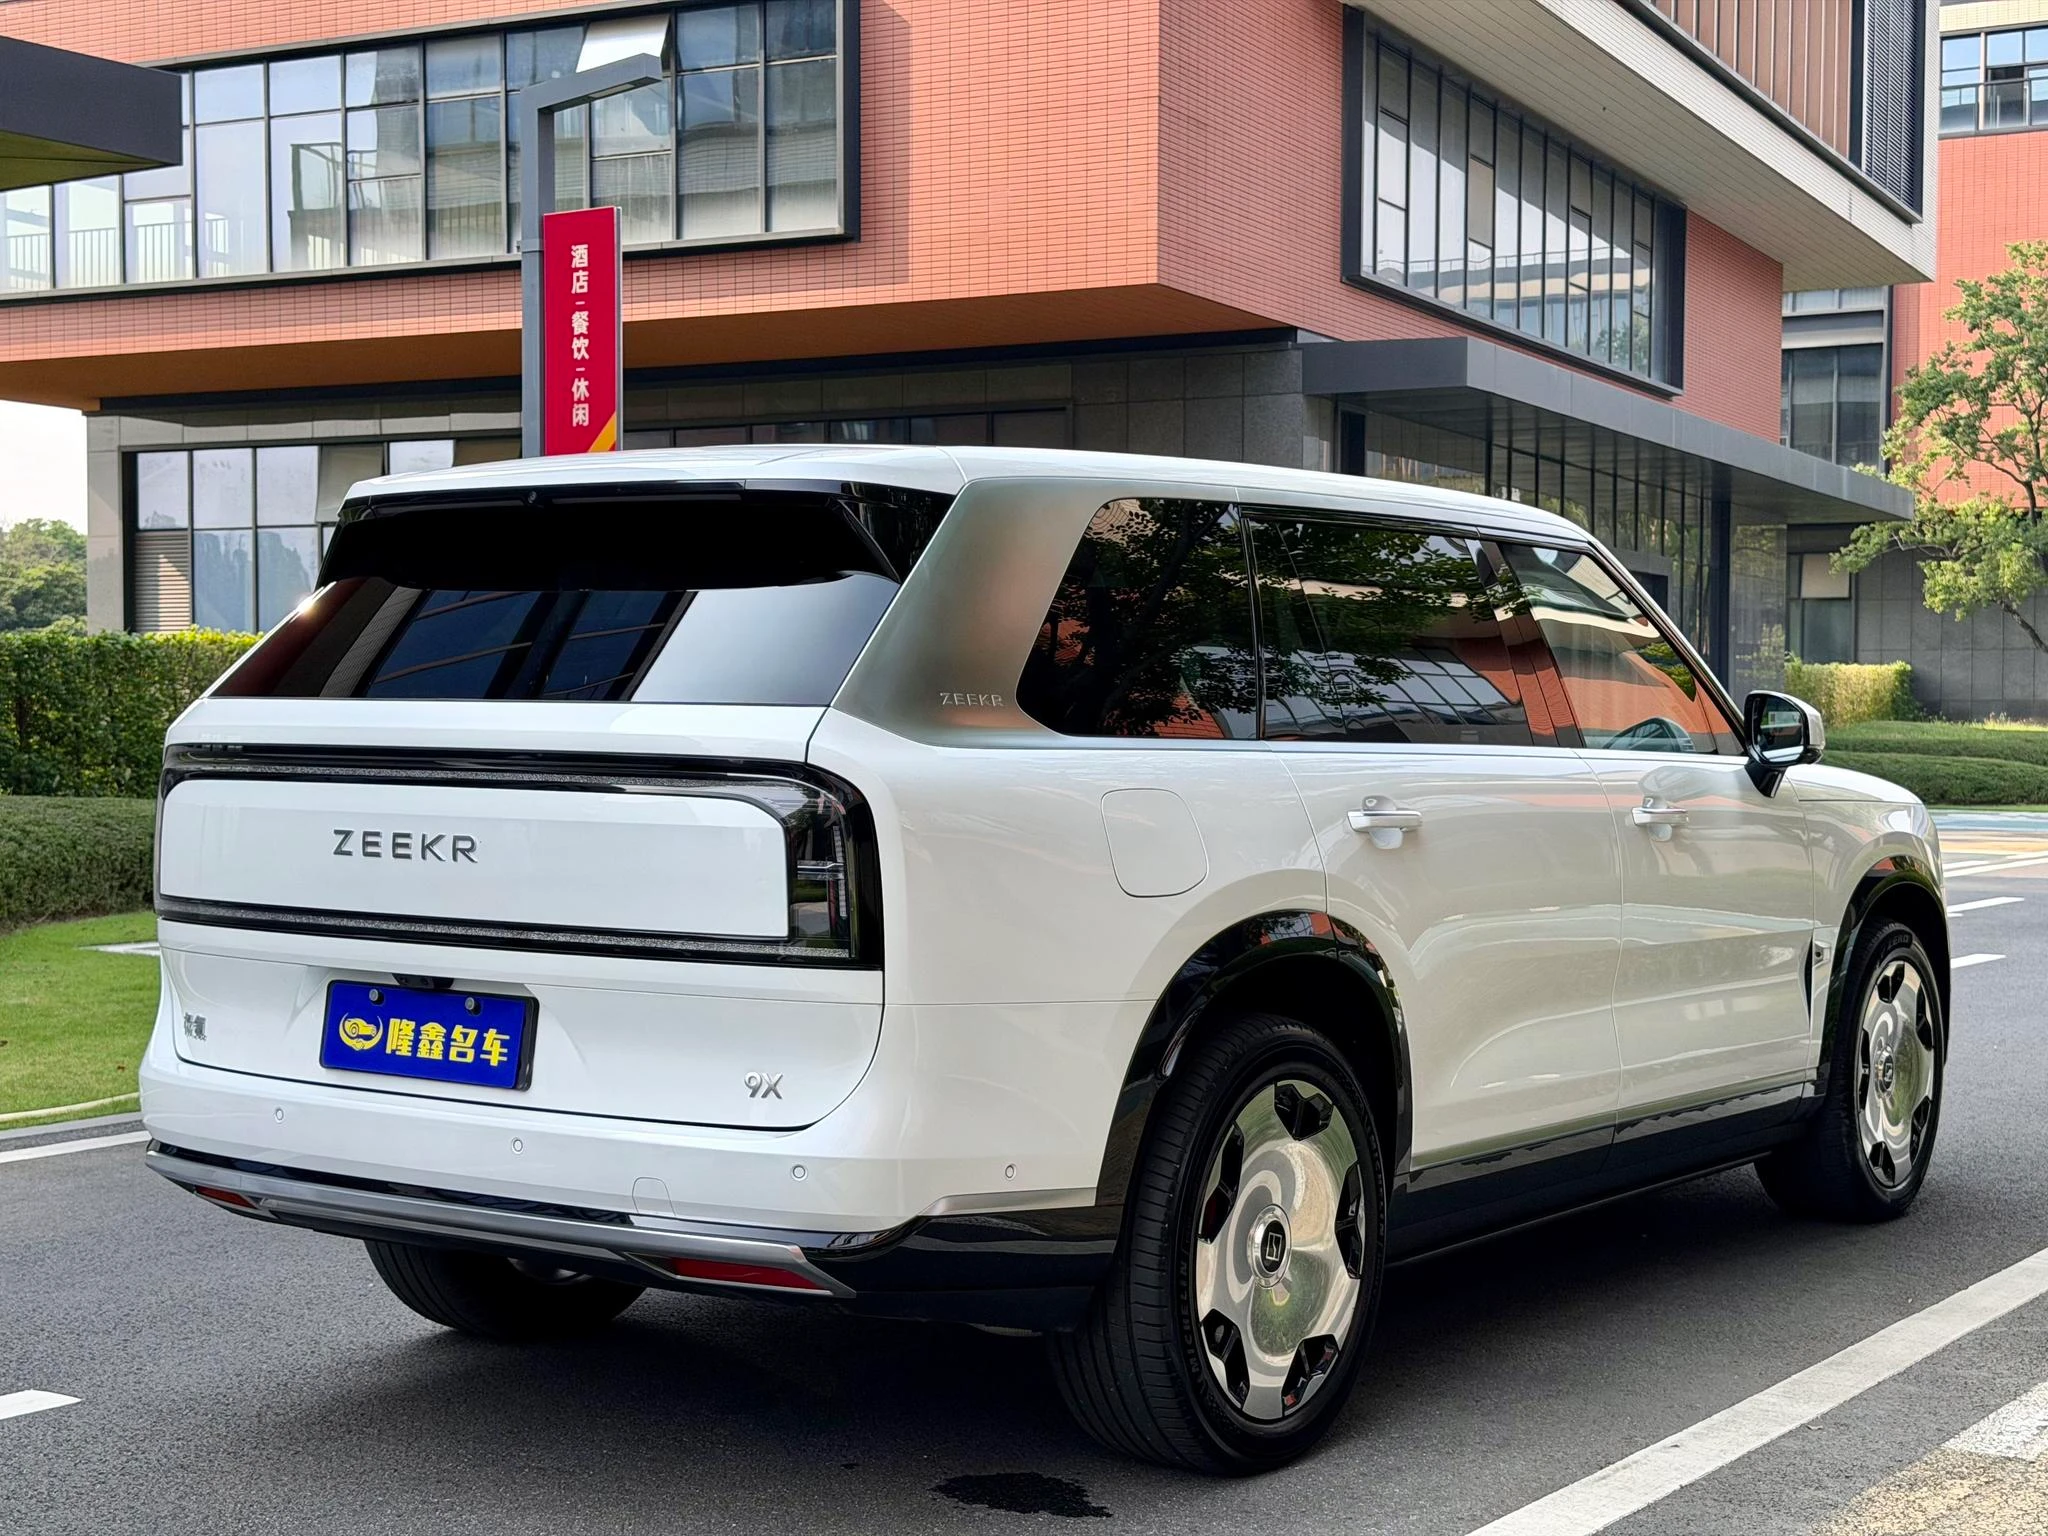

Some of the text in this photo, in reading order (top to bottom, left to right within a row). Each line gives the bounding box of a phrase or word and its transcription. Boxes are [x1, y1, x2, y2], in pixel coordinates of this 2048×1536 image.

[940, 692, 1004, 707] ZEEKR
[333, 829, 478, 863] ZEEKR
[386, 1018, 510, 1067] 隆鑫名车
[744, 1071, 784, 1100] 9X
[1180, 1260, 1200, 1373] MICHELIN
